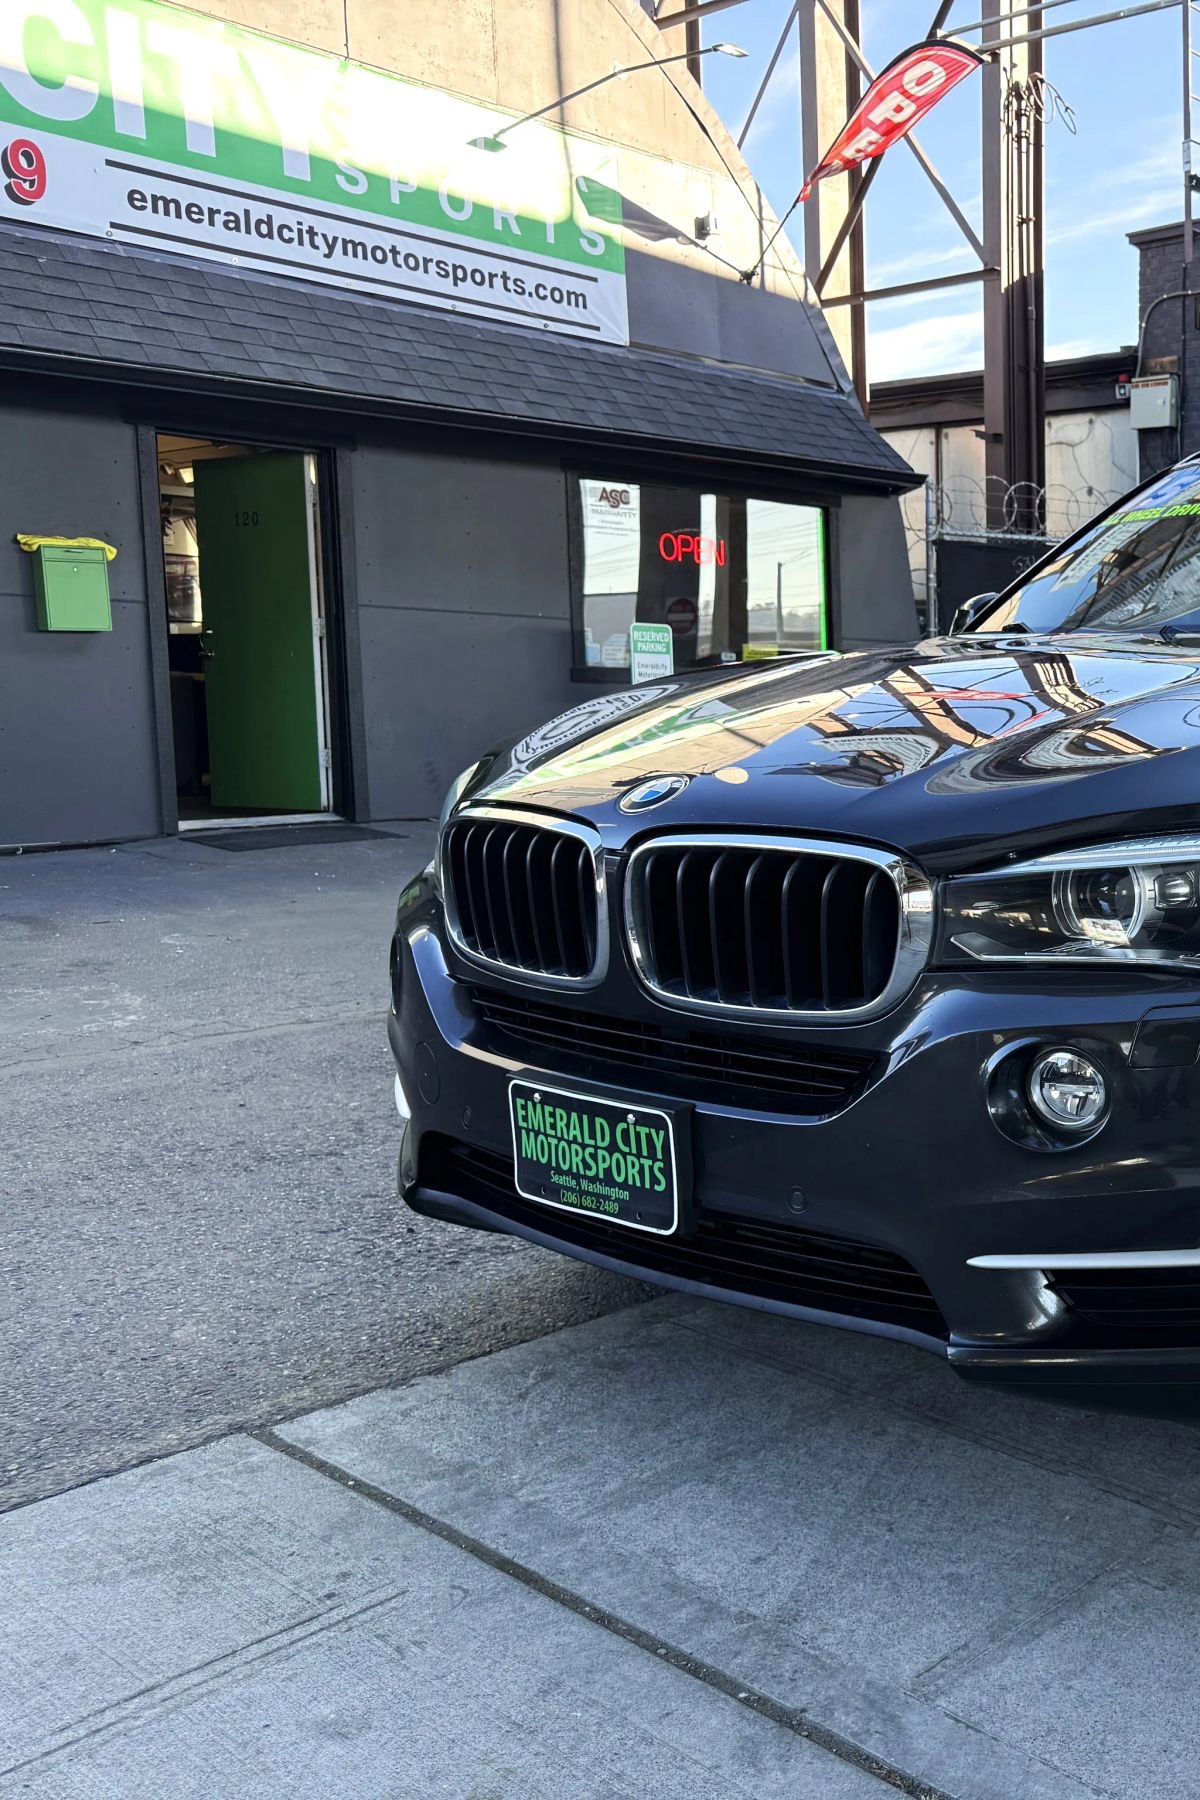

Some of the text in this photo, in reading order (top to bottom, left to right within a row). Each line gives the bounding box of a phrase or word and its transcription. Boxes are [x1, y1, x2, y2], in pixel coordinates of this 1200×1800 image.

[0, 0, 338, 181] CITY
[1, 137, 47, 206] 9
[127, 187, 588, 310] emeraldcitymotorsports.com
[598, 486, 631, 509] ASC
[235, 511, 260, 527] 120
[659, 532, 726, 567] OPEN
[633, 631, 670, 643] RESERVED
[637, 641, 667, 652] PARKING
[516, 1097, 665, 1159] EMERALD CITY
[521, 1129, 667, 1192] MOTORSPORTS
[550, 1169, 629, 1200] Seattle, Washington
[560, 1188, 619, 1214] (206) 682-2489
